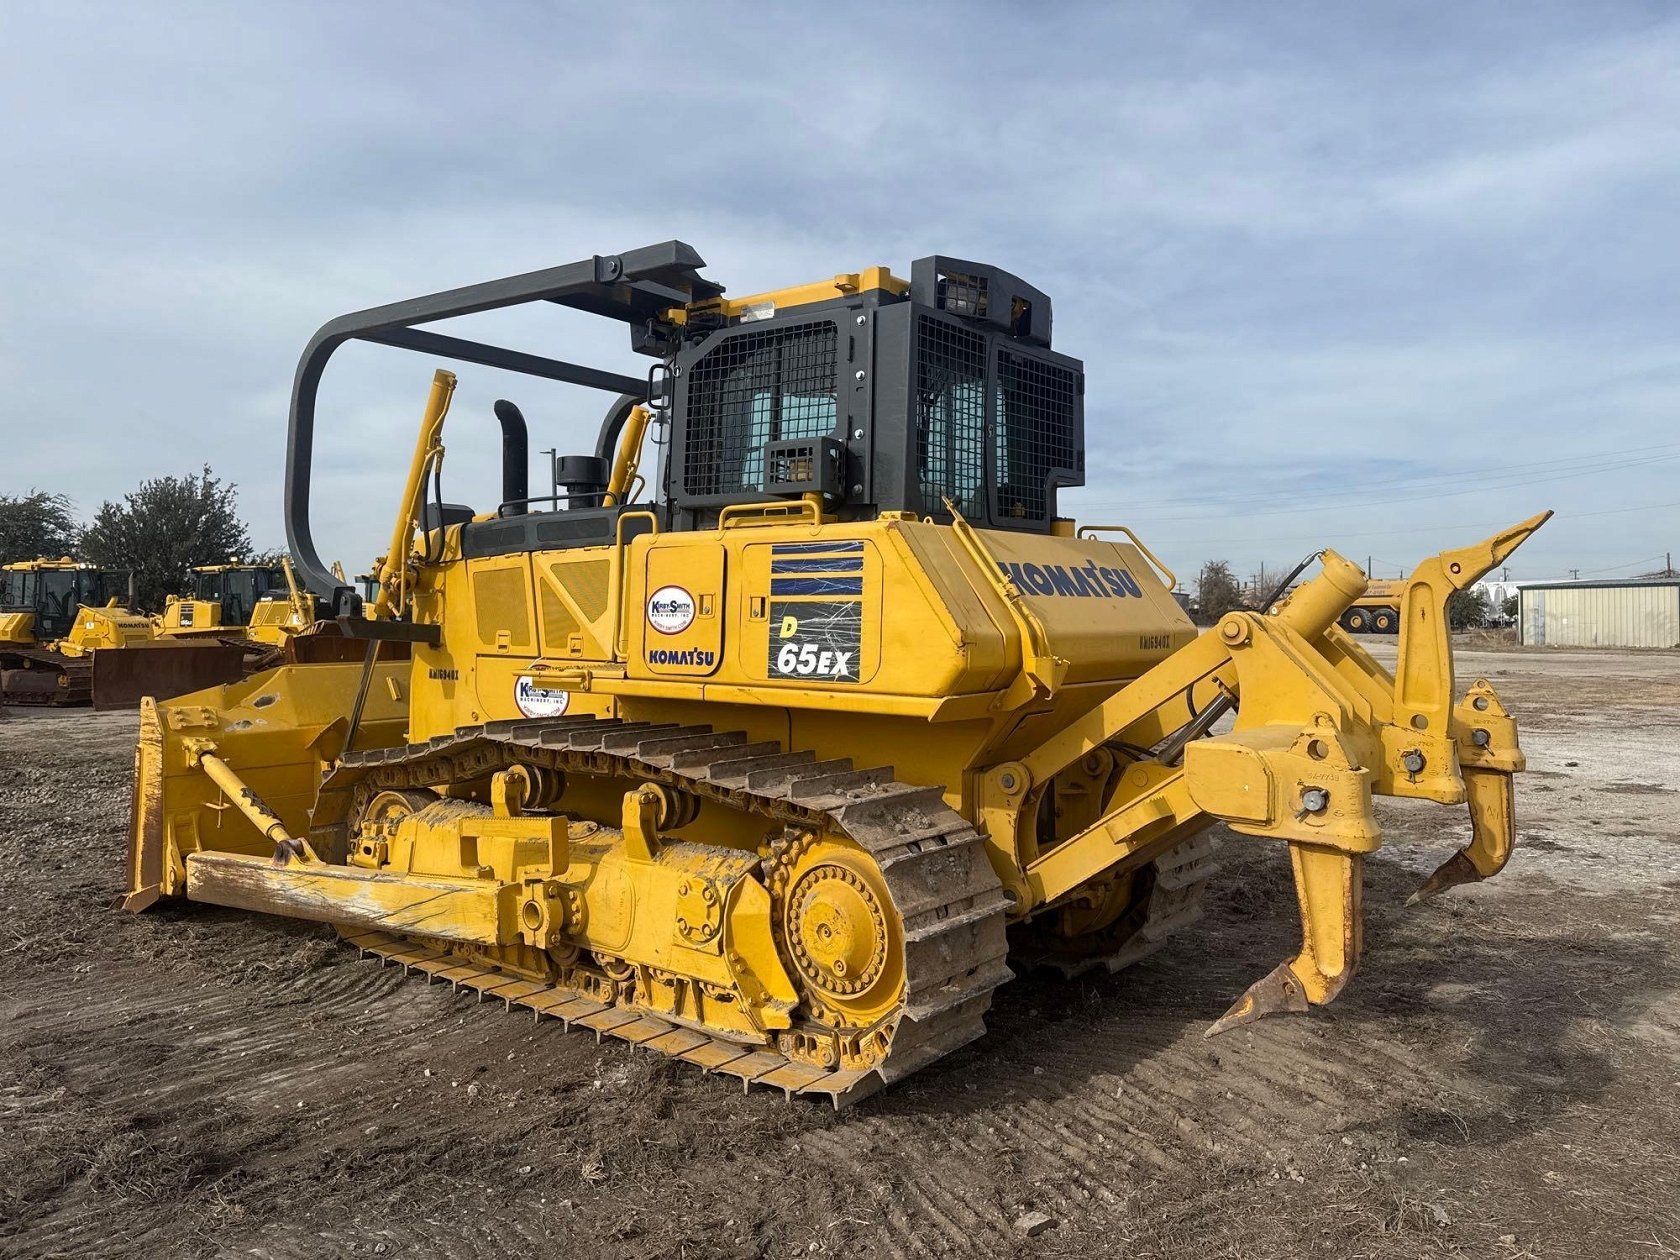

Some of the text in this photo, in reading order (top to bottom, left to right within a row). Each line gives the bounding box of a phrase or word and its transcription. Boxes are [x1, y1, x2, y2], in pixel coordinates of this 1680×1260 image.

[996, 559, 1142, 598] KOMATSU
[780, 616, 798, 639] D
[649, 647, 715, 666] KOMATSU
[777, 643, 853, 676] 65EX
